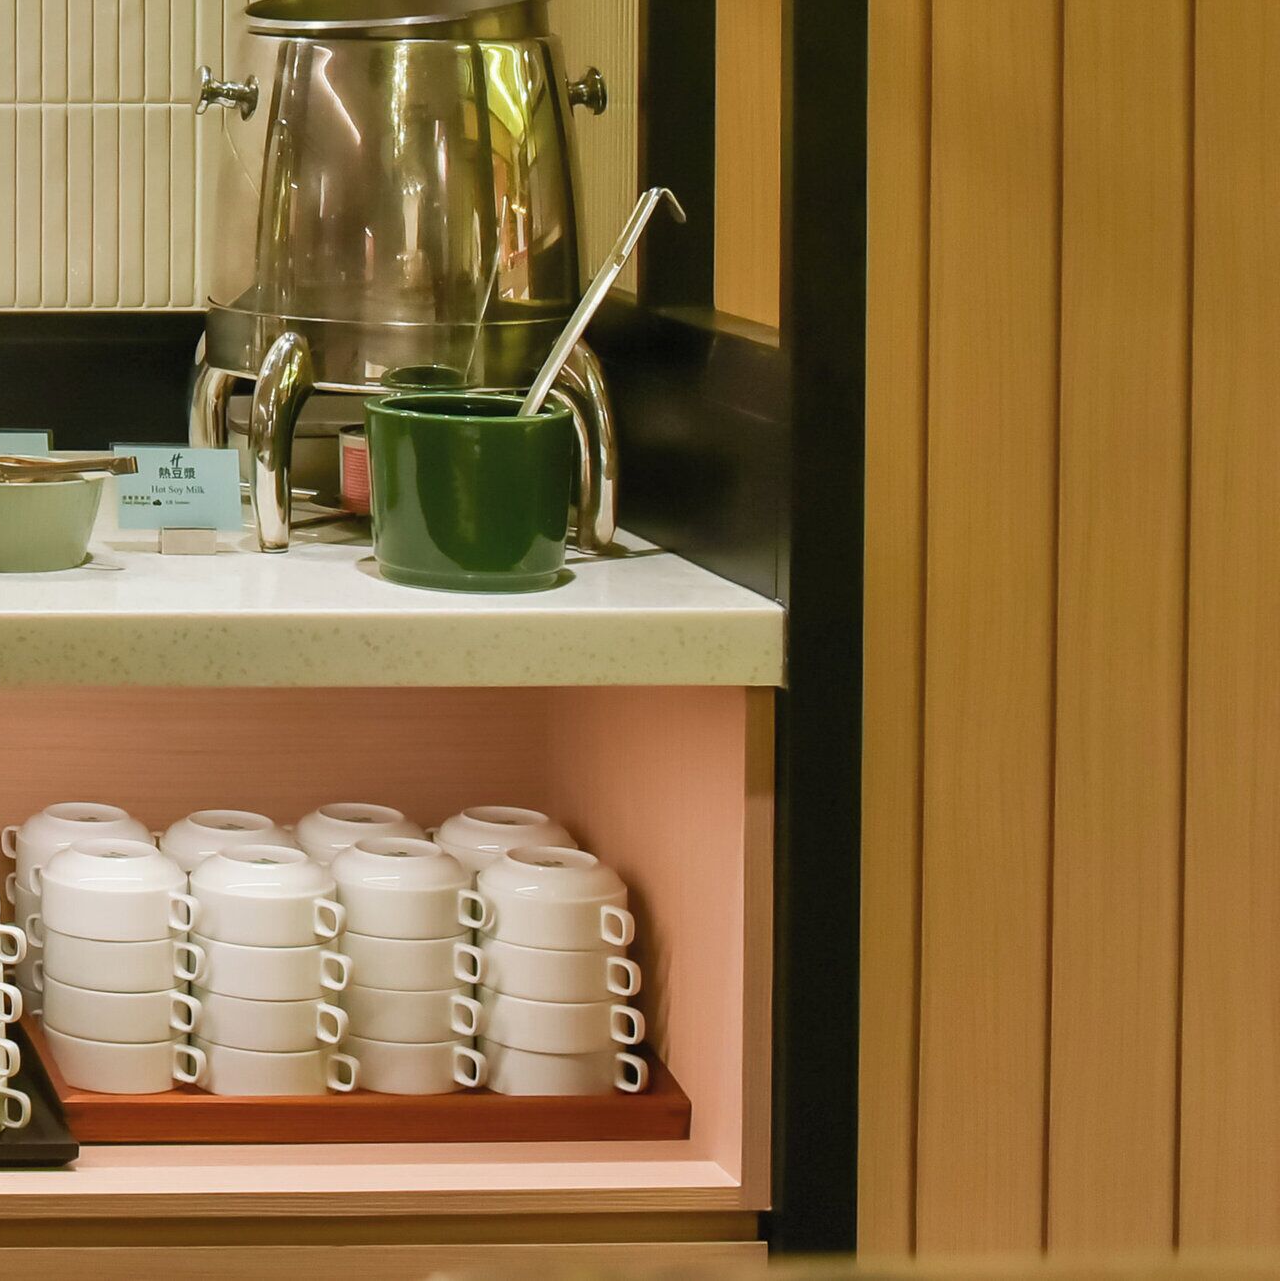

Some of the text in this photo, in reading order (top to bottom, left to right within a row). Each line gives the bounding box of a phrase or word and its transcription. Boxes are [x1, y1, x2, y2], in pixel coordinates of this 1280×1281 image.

[159, 467, 196, 479] 熱豆漿
[151, 485, 205, 495] Hot Soy Milk
